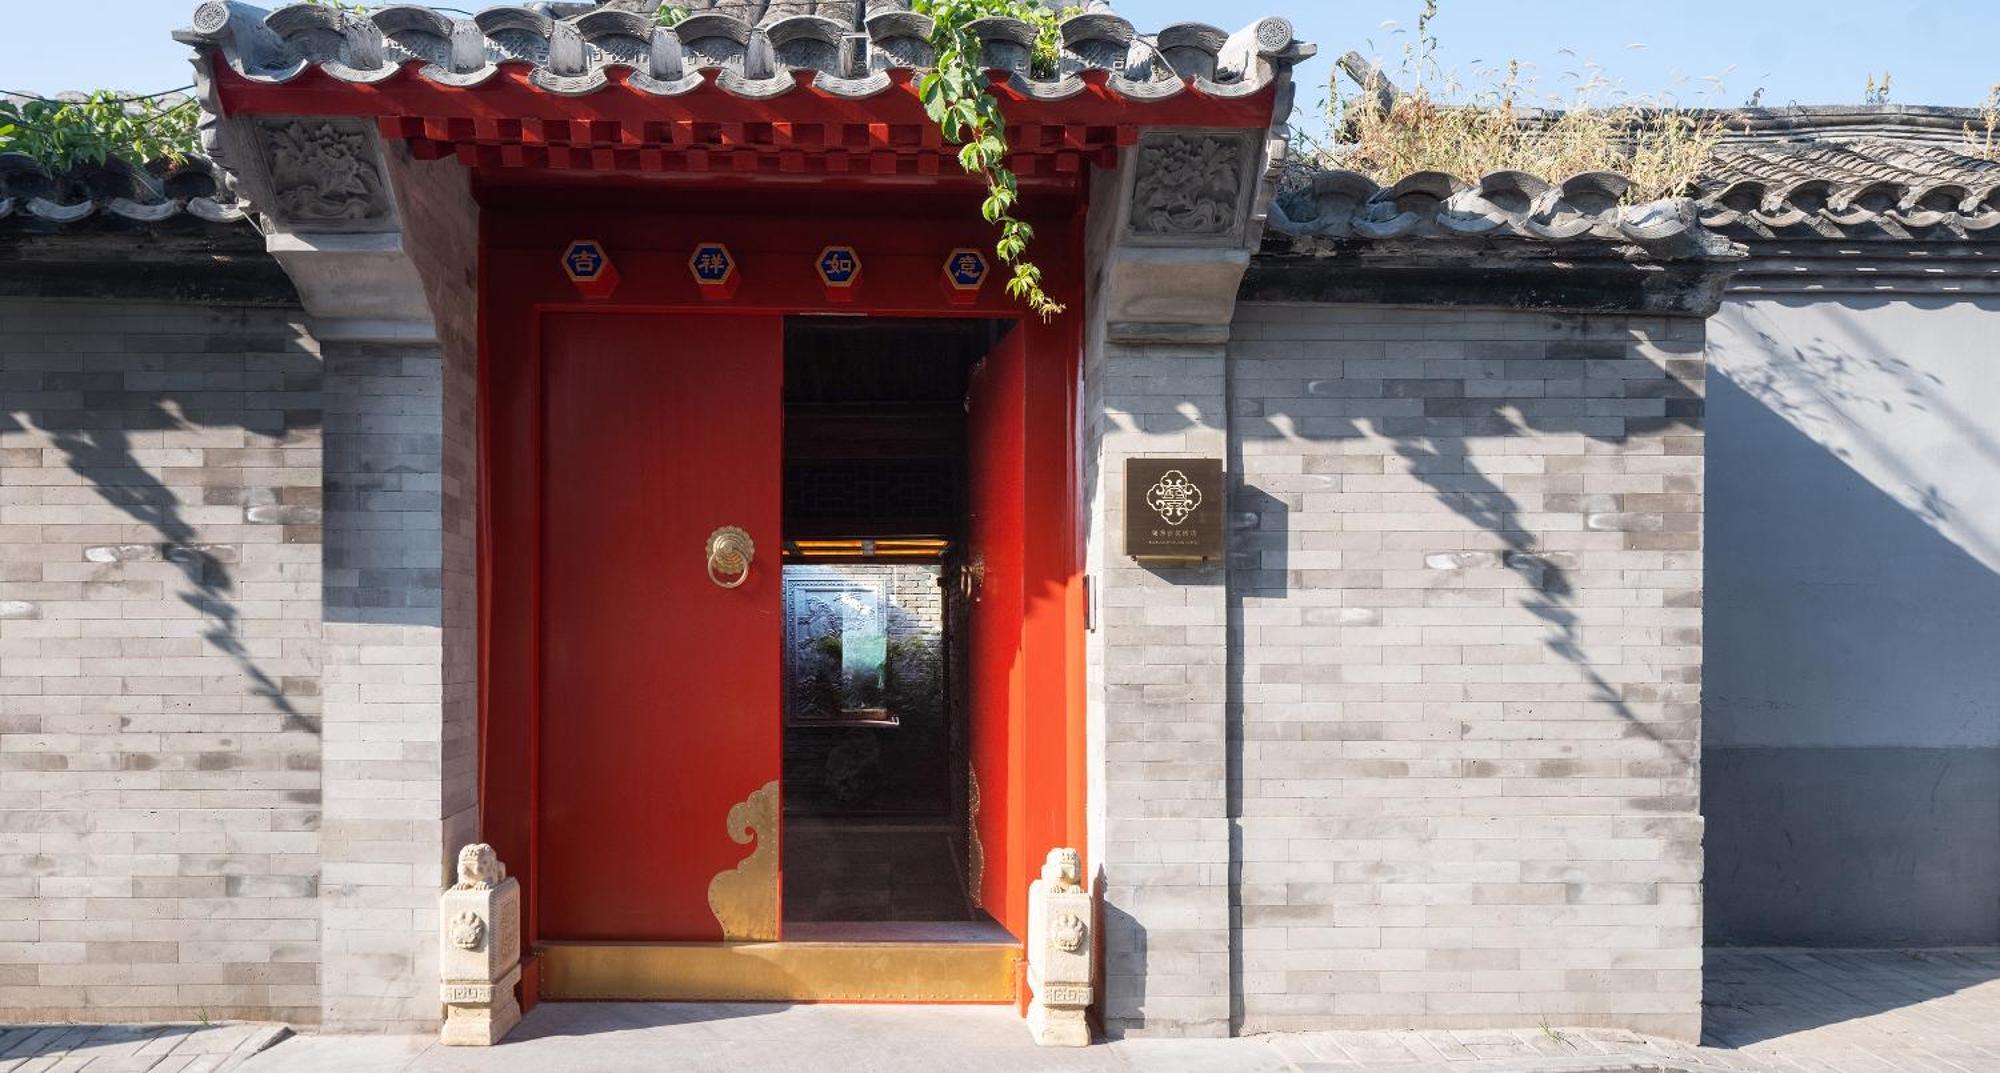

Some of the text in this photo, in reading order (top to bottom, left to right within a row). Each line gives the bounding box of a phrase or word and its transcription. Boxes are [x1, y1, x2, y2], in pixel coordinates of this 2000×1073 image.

[570, 249, 981, 279] 吉 祥 如 意
